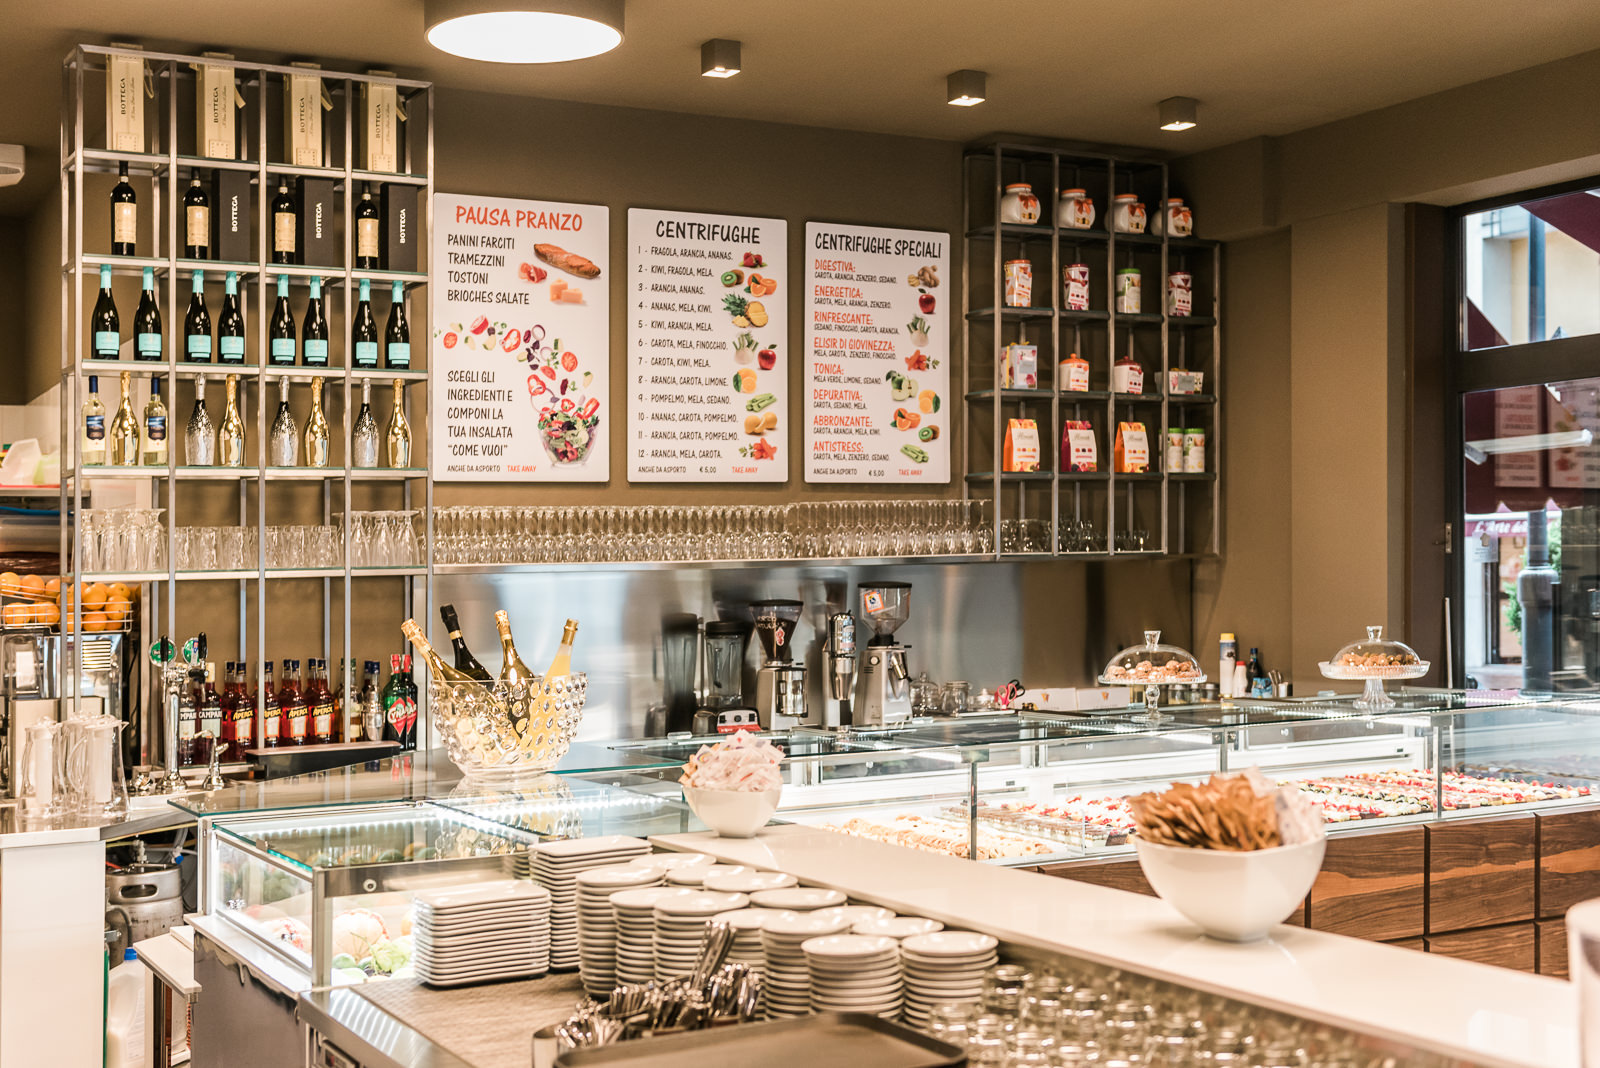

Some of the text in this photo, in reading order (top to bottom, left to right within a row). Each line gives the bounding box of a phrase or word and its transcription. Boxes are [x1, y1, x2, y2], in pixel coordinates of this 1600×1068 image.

[456, 205, 582, 232] PAUSA PRANZO
[656, 220, 760, 244] CENTRIFUGHE
[448, 234, 515, 250] PANINI FARCITI
[815, 233, 941, 259] CENTRIFUGHE SPECIALI
[448, 252, 505, 267] TRAMEZZINI
[638, 264, 643, 273] 2
[815, 259, 856, 273] DIGESTIVA:
[448, 271, 488, 284] TOSTONI
[638, 283, 643, 292] 3
[815, 285, 864, 299] ENERGETICA:
[448, 290, 529, 305] BRIOCHES SALATE
[638, 320, 643, 328] 5
[814, 311, 874, 325] RINFRESCANTE:
[638, 338, 643, 347] 6
[814, 337, 896, 352] ELISIR DI GIOVINEZZA:
[638, 357, 643, 365] 7
[814, 363, 844, 375] TONICA:
[448, 370, 495, 383] SCEGLI GLI
[638, 376, 643, 384] 8
[814, 375, 826, 383] MELA
[448, 389, 513, 402] INGREDIENTI E
[638, 394, 643, 402] 9
[814, 389, 863, 401] DEPURATIVA:
[448, 407, 503, 420] COMPONI LA
[638, 412, 645, 421] 10
[814, 415, 873, 427] ABBRONZANTE:
[448, 426, 513, 438] TUA INSALATA
[813, 441, 864, 453] ANTISTRESS:
[639, 449, 645, 458] 12
[507, 465, 520, 473] TAKE
[732, 466, 744, 474] TAKE
[233, 710, 253, 720] APEROL
[289, 708, 308, 718] APEROL
[313, 706, 333, 716] APEROL
